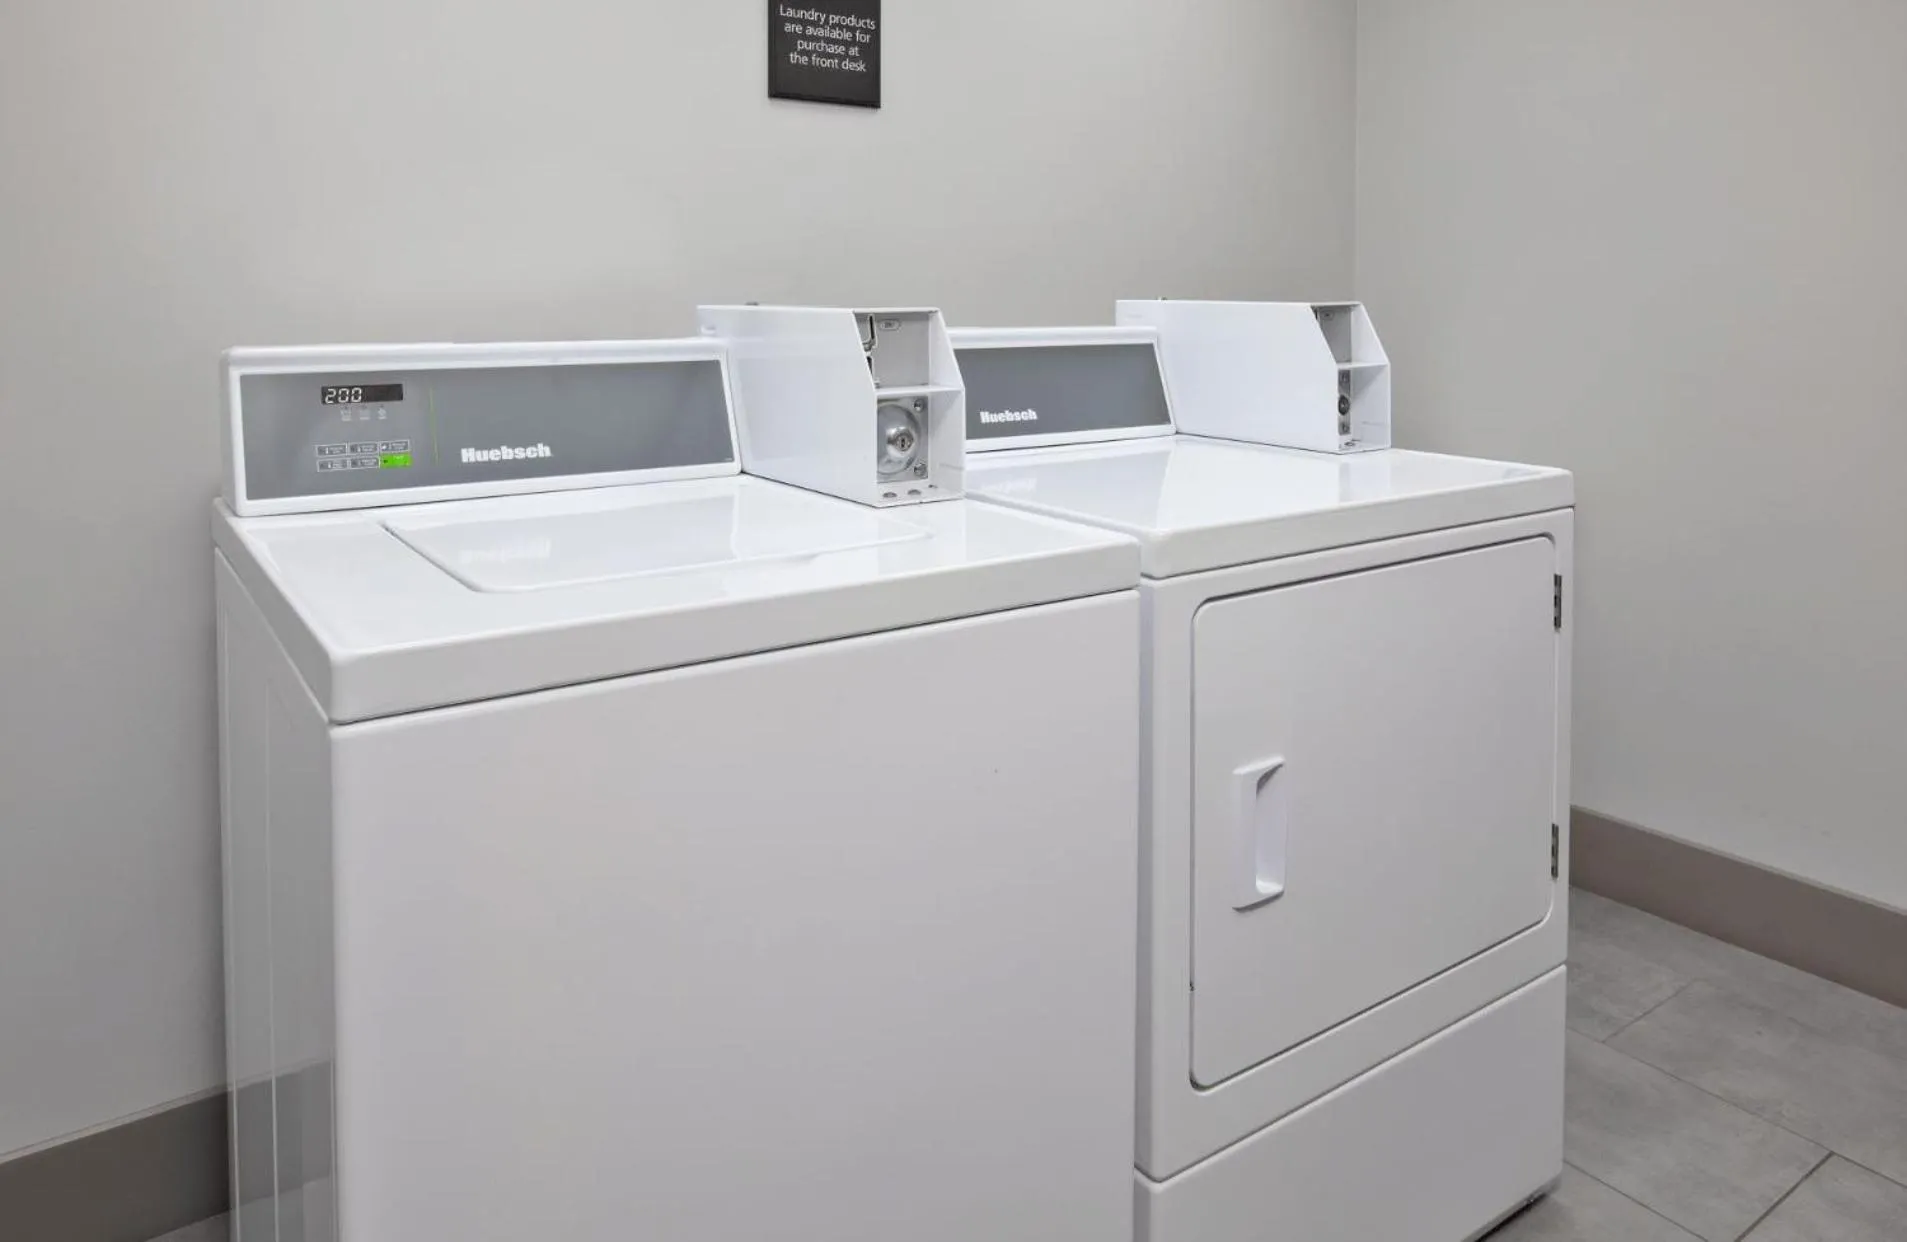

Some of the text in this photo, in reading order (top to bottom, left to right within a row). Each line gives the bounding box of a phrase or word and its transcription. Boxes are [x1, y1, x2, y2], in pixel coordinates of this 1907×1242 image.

[779, 4, 876, 30] Laundry products
[784, 22, 871, 43] are available for
[797, 39, 860, 56] purchase at
[789, 51, 867, 72] the front desk
[325, 387, 362, 404] 200
[979, 408, 1038, 424] Huebsch
[460, 442, 552, 463] Huebsch
